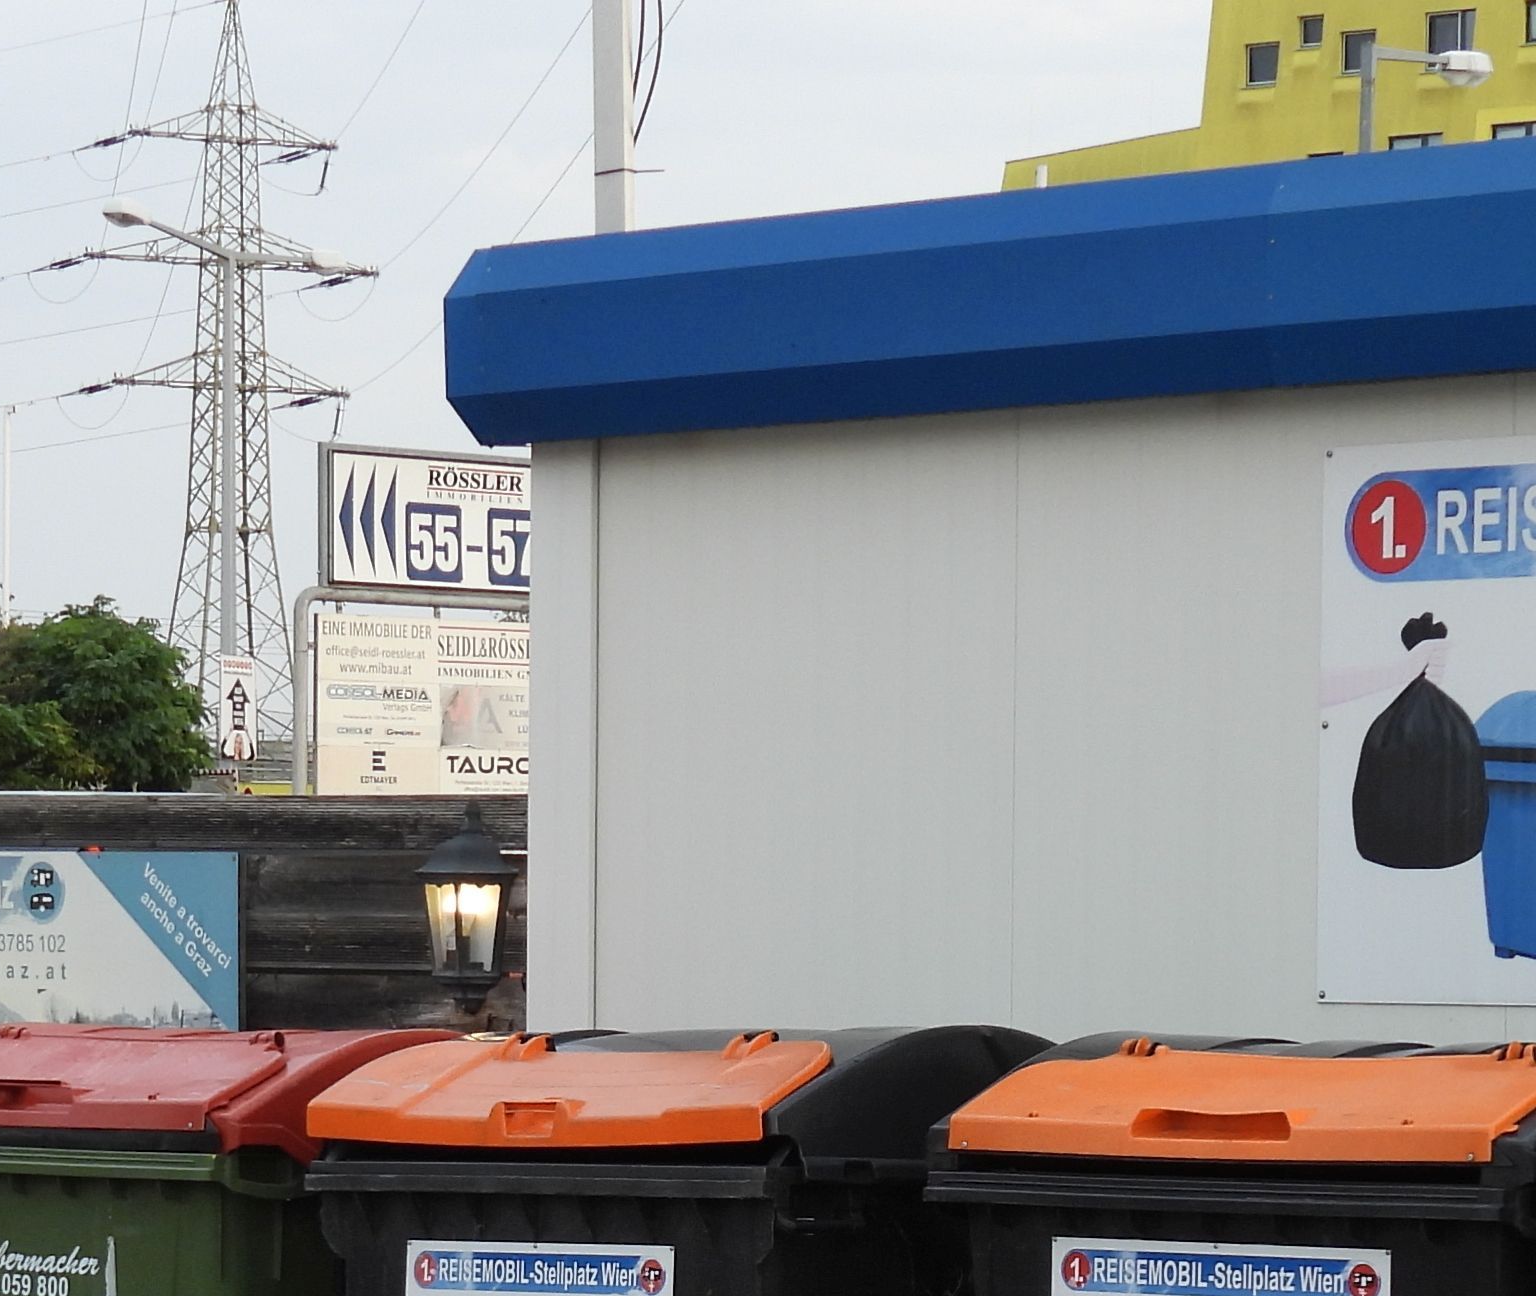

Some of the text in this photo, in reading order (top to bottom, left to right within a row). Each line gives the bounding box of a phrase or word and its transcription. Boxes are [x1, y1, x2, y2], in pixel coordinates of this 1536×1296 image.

[428, 466, 522, 492] RÖSSLER
[1370, 496, 1407, 560] 1.
[322, 620, 432, 640] EINE IMMOBILIE DER
[339, 661, 412, 676] www.mibau.at
[437, 667, 513, 679] IMMOBILIEN
[144, 862, 232, 969] Venite a trovarci
[40, 934, 66, 953] 102
[140, 892, 212, 977] anche a Graz
[2, 1273, 31, 1296] 059
[439, 1259, 598, 1290] REISEMOBIL-Stellplatz
[602, 1262, 636, 1287] Wien
[1093, 1257, 1295, 1296] REISEMOBIL-Stellplatz
[1300, 1266, 1344, 1294] Wien
